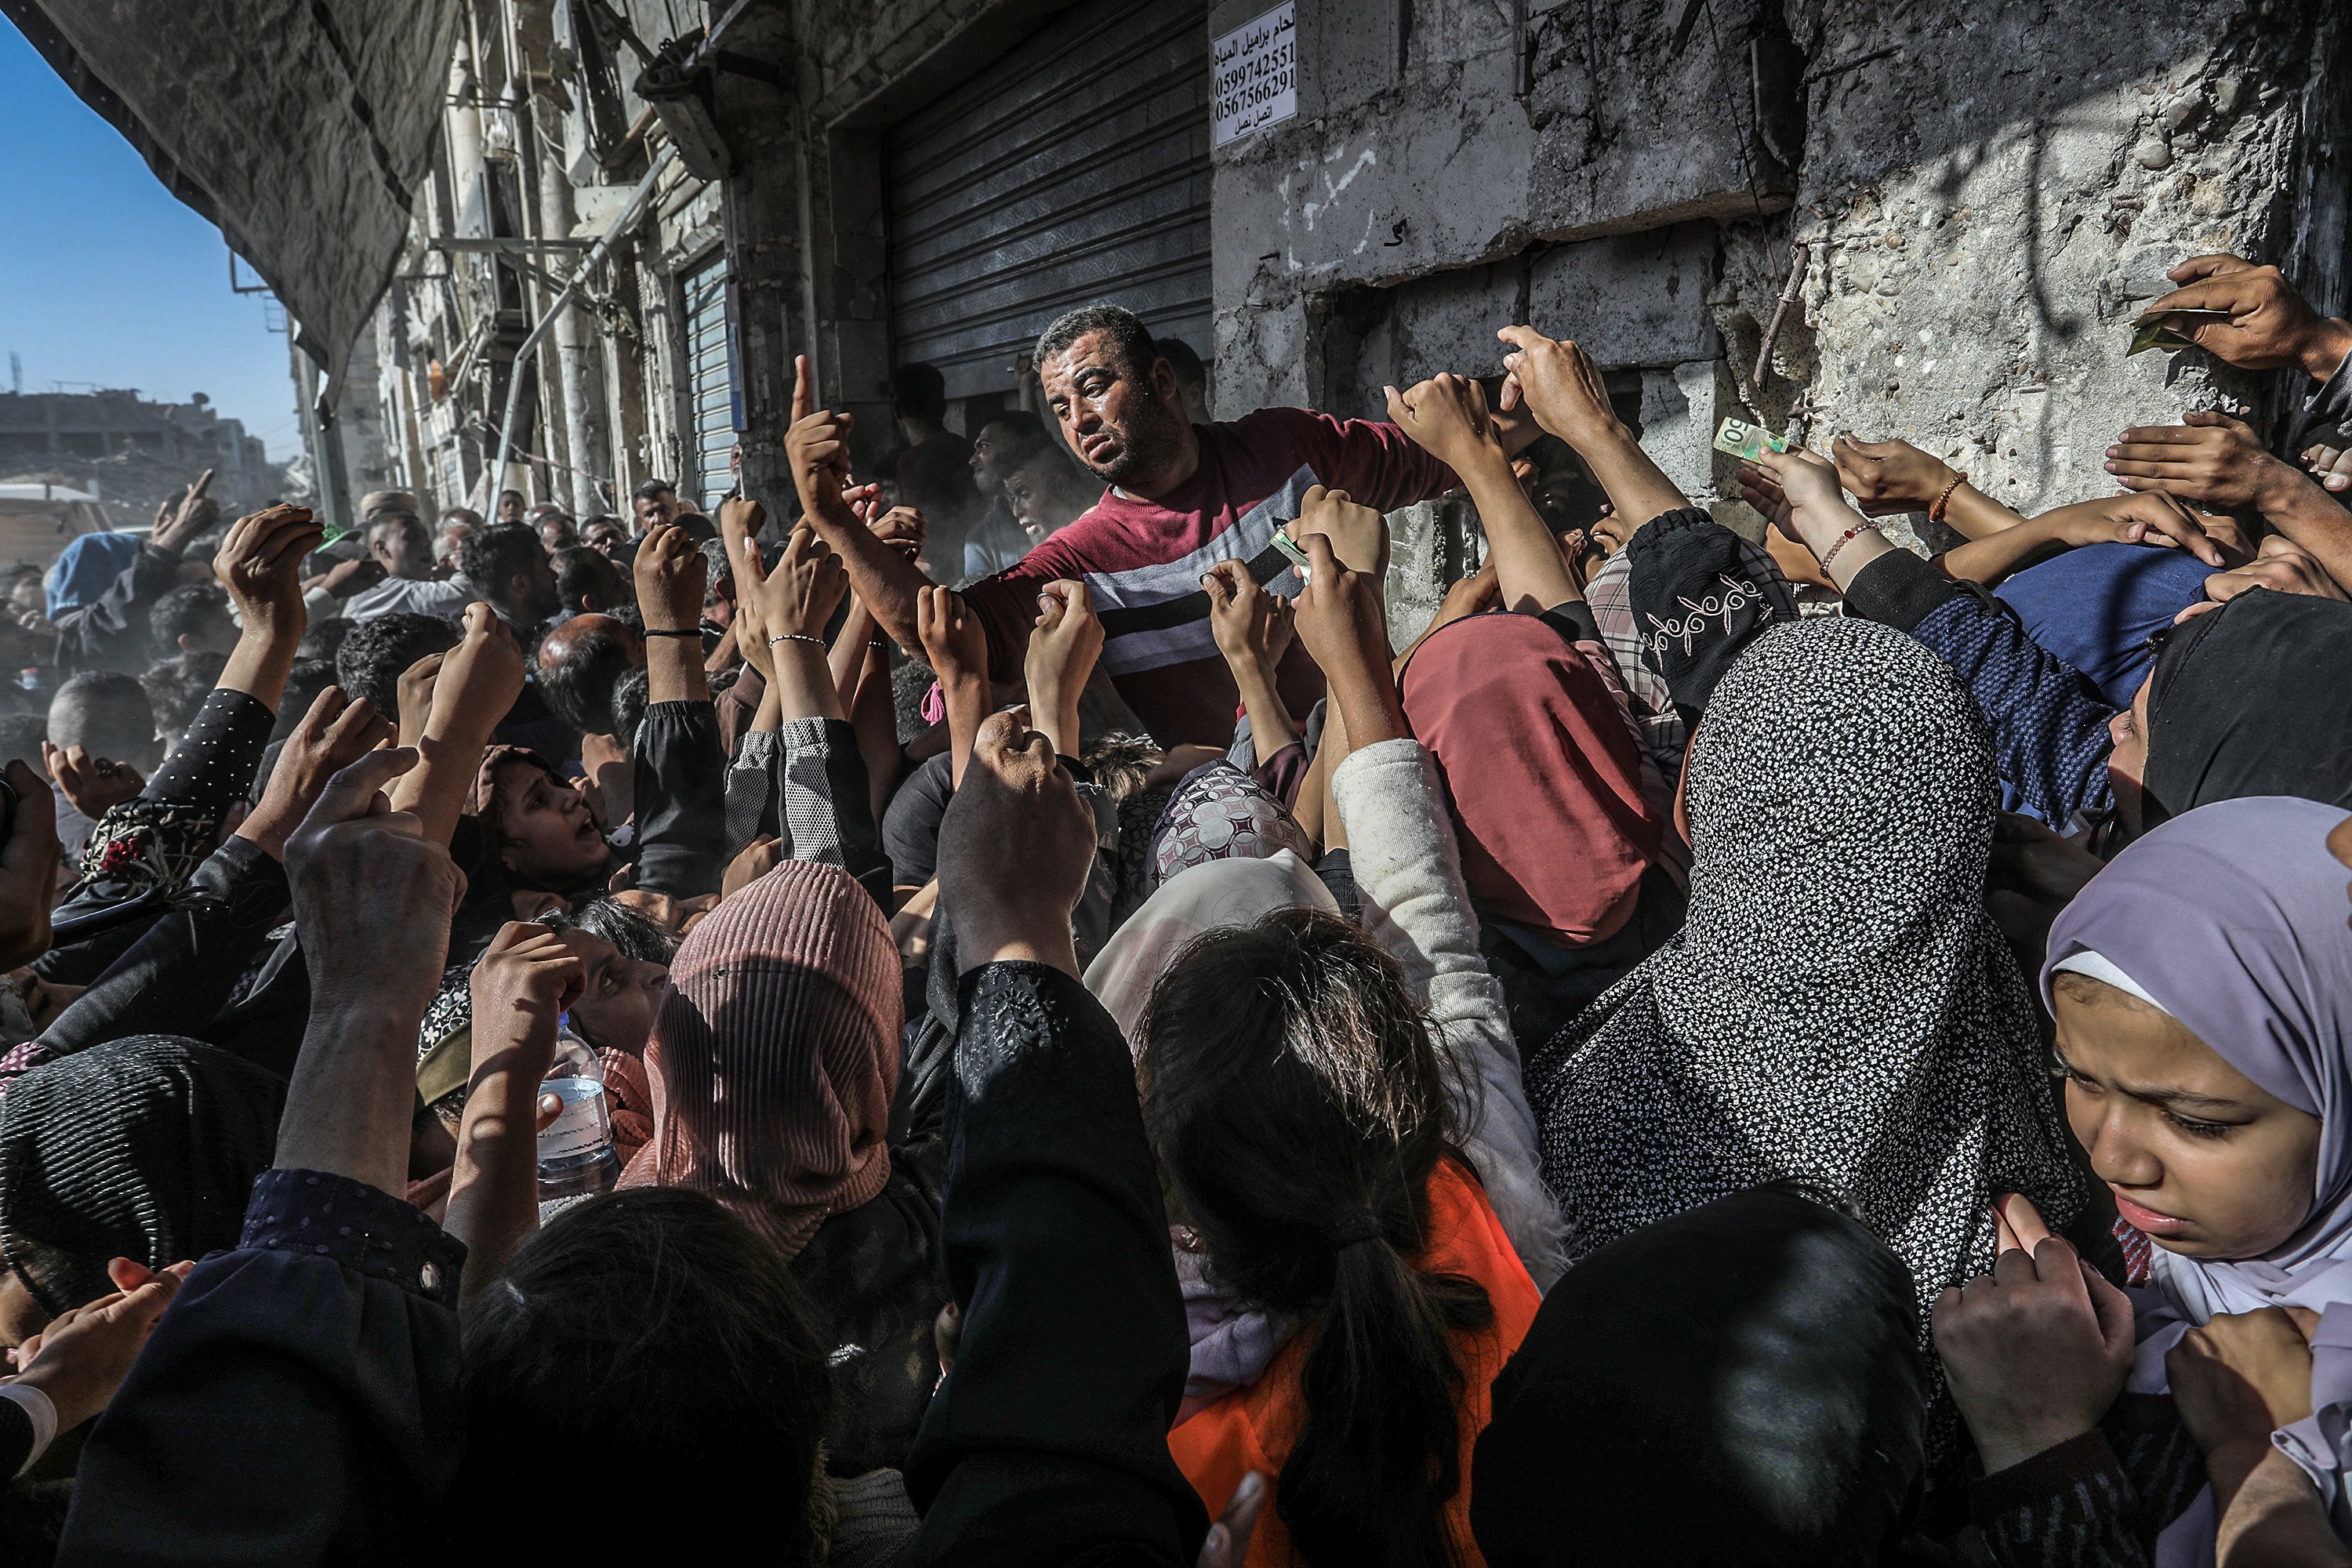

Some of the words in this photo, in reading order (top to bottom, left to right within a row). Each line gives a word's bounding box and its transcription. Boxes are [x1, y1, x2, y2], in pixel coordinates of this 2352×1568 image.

[1242, 25, 1269, 56] براميل
[1273, 8, 1295, 45] لحام
[1214, 39, 1238, 67] المياه
[1216, 41, 1295, 98] 0599742551
[1216, 67, 1295, 122] 0567566291
[1235, 114, 1251, 135] نصل
[1254, 104, 1272, 127] اتصل
